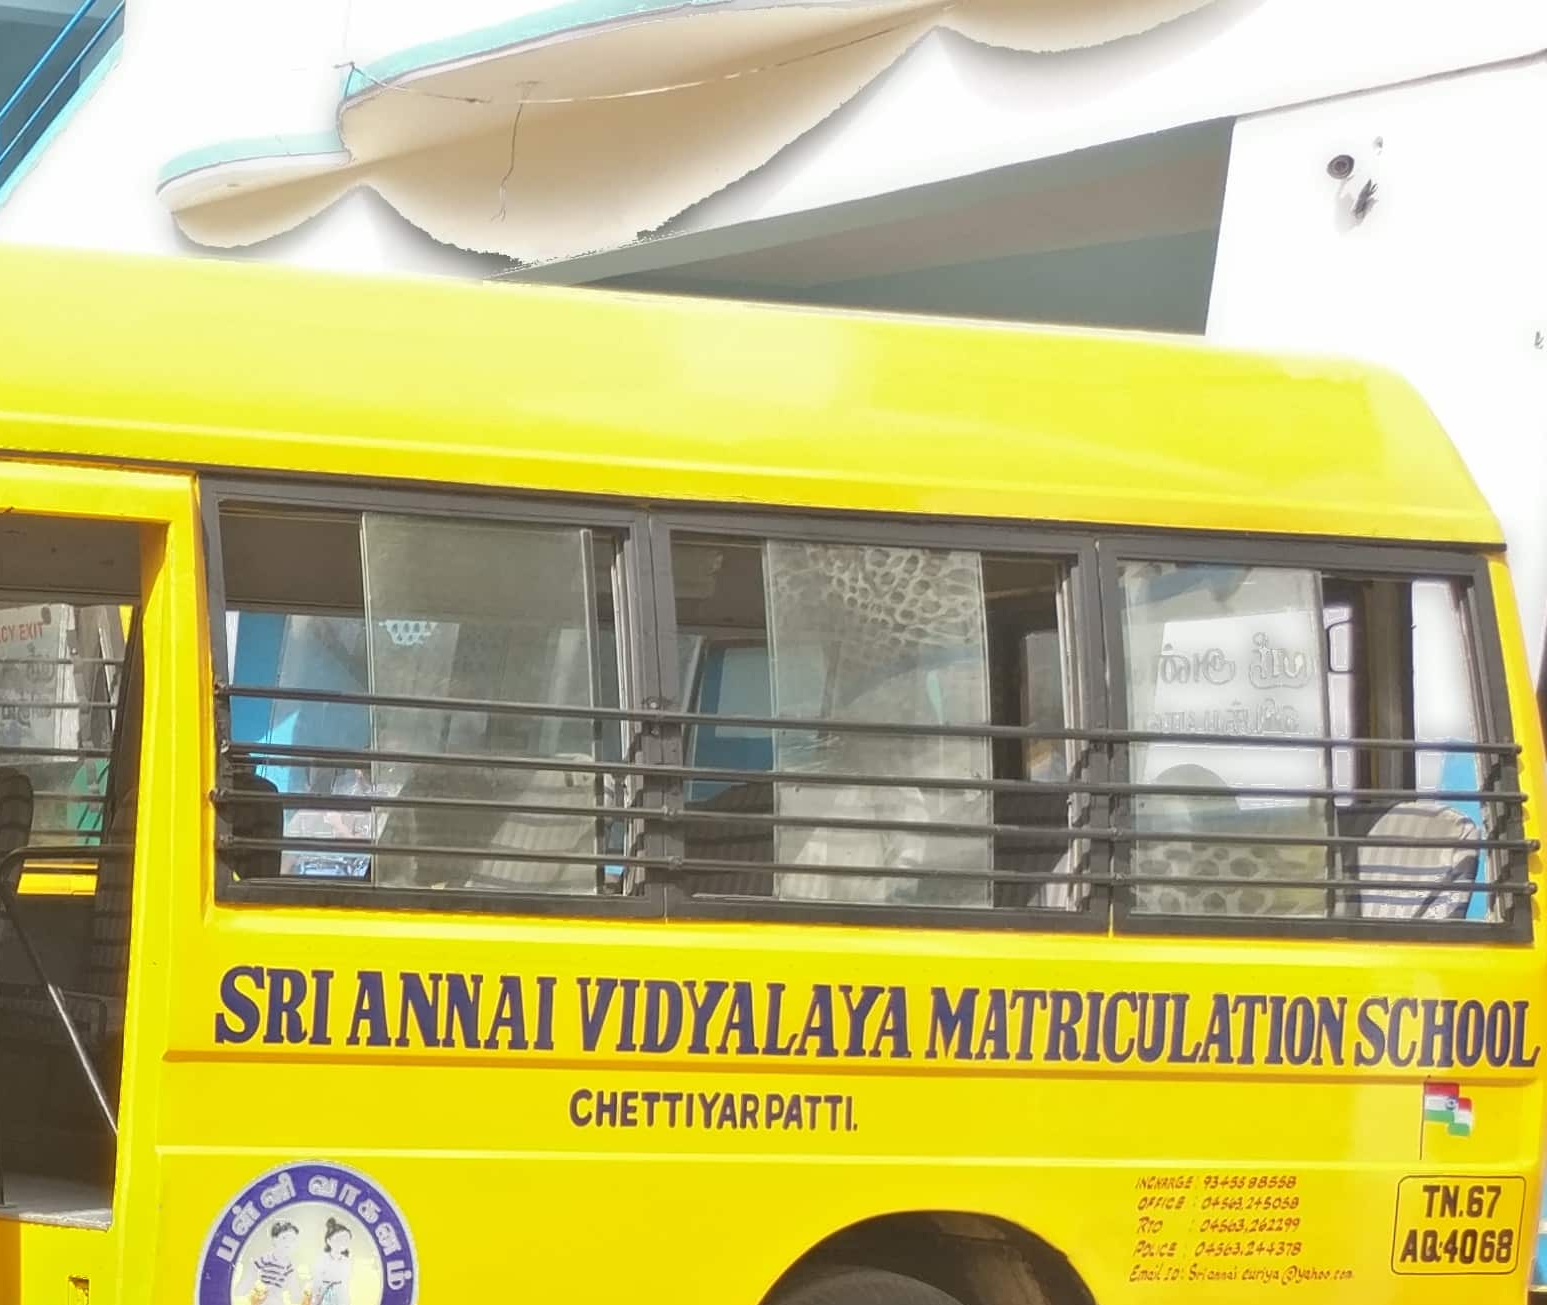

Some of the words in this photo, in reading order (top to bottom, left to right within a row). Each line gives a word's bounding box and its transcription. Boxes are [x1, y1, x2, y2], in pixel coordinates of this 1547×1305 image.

[19, 620, 44, 641] EXIT
[214, 965, 334, 1045] SRI
[345, 970, 557, 1051] ANNAI
[576, 977, 912, 1059] VIDYALAYA
[924, 986, 1349, 1066] MATRICULATION
[1353, 997, 1542, 1069] SCHOOL
